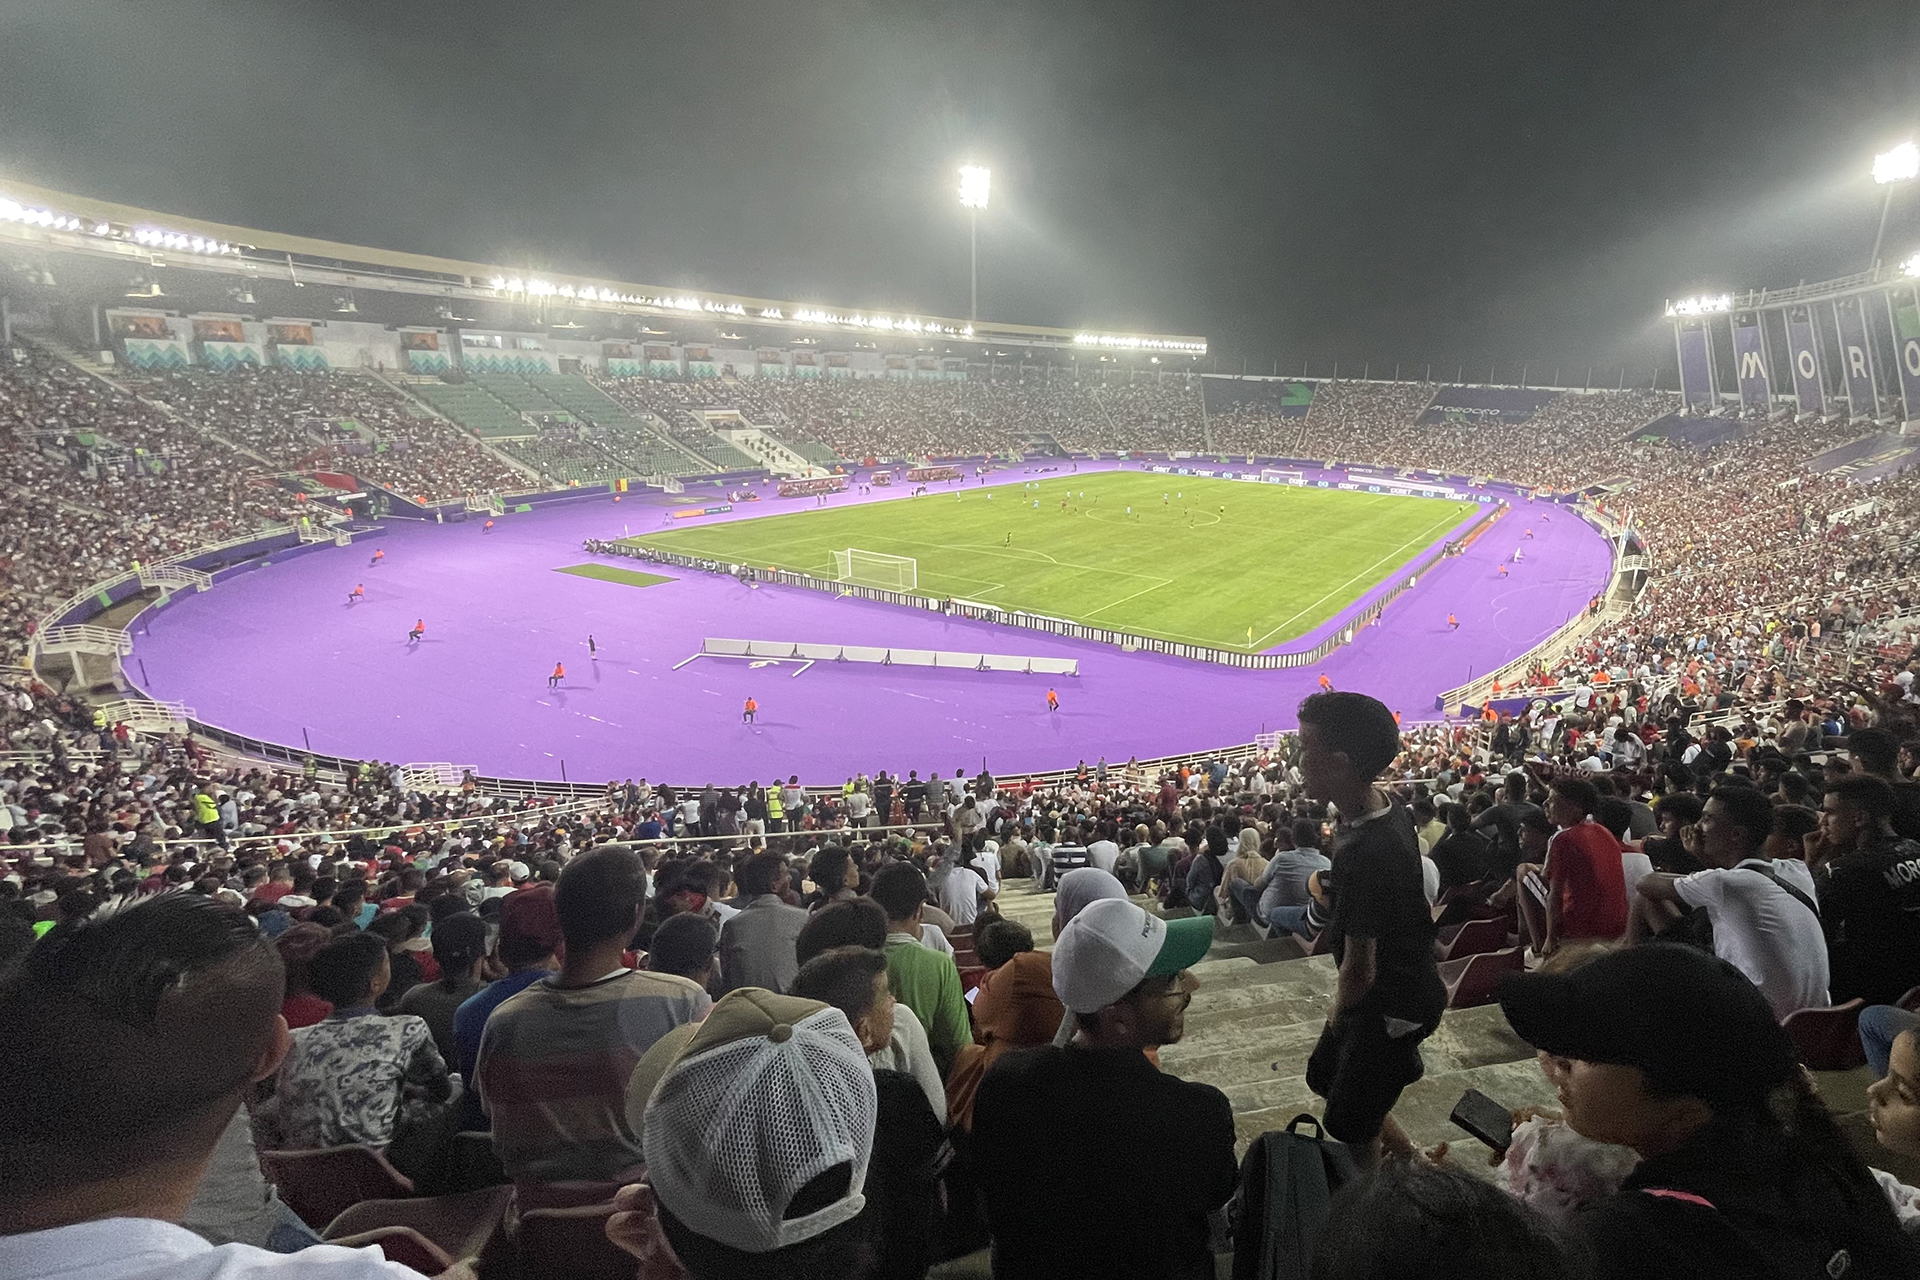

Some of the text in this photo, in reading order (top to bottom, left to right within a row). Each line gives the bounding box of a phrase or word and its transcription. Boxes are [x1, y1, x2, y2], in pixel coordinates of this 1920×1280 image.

[1430, 404, 1500, 416] MOROCCO
[543, 415, 550, 423] 2
[322, 422, 330, 431] 3
